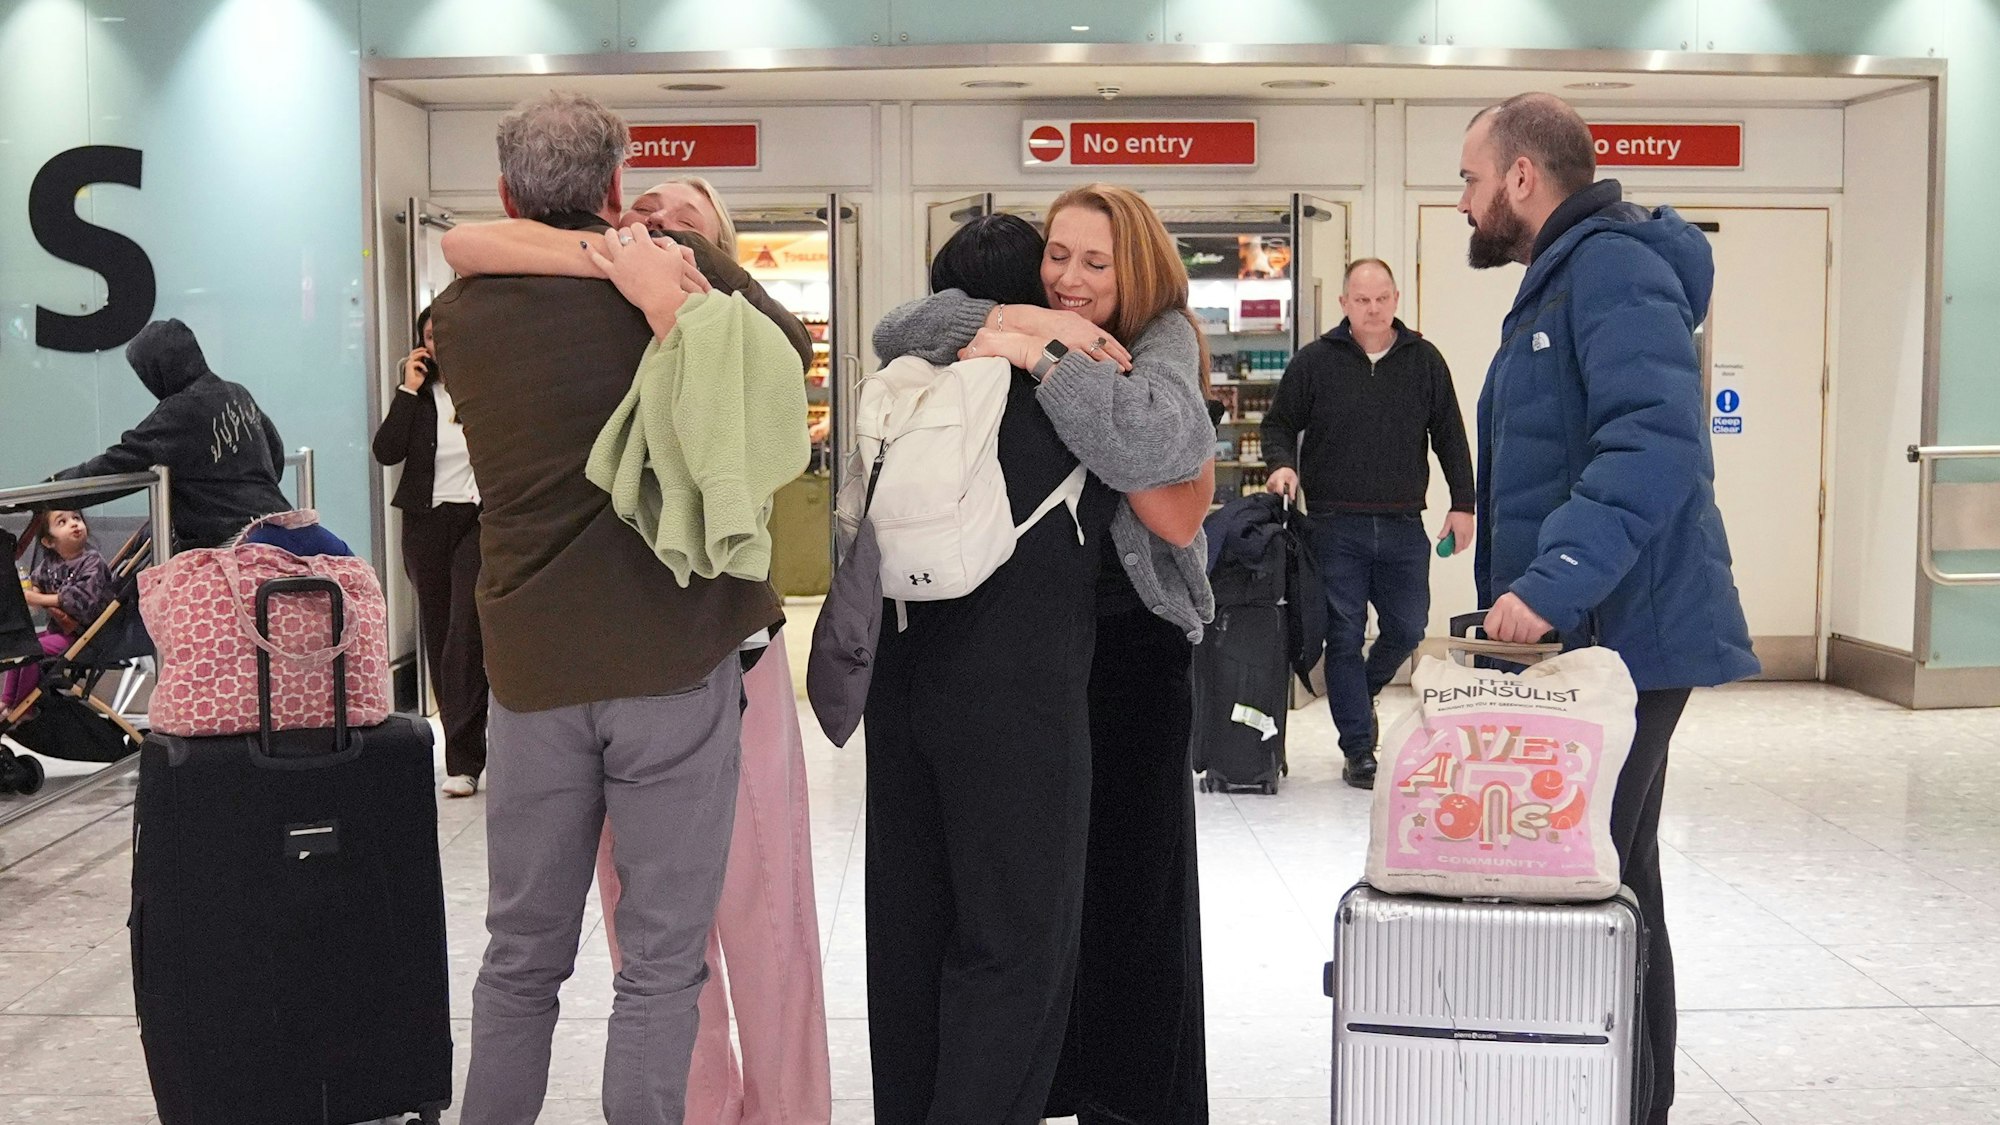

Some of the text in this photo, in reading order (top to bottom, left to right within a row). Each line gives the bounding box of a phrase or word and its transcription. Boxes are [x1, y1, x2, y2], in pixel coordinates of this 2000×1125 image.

[630, 138, 696, 161] entry
[1083, 133, 1193, 158] No entry
[1593, 136, 1681, 160] o entry
[1713, 425, 1740, 433] Clear
[1714, 417, 1740, 426] Keep
[1474, 677, 1525, 687] THE
[1423, 686, 1581, 704] PENINSULIST
[1456, 725, 1560, 765] WE
[1437, 855, 1547, 869] COMMUNITY
